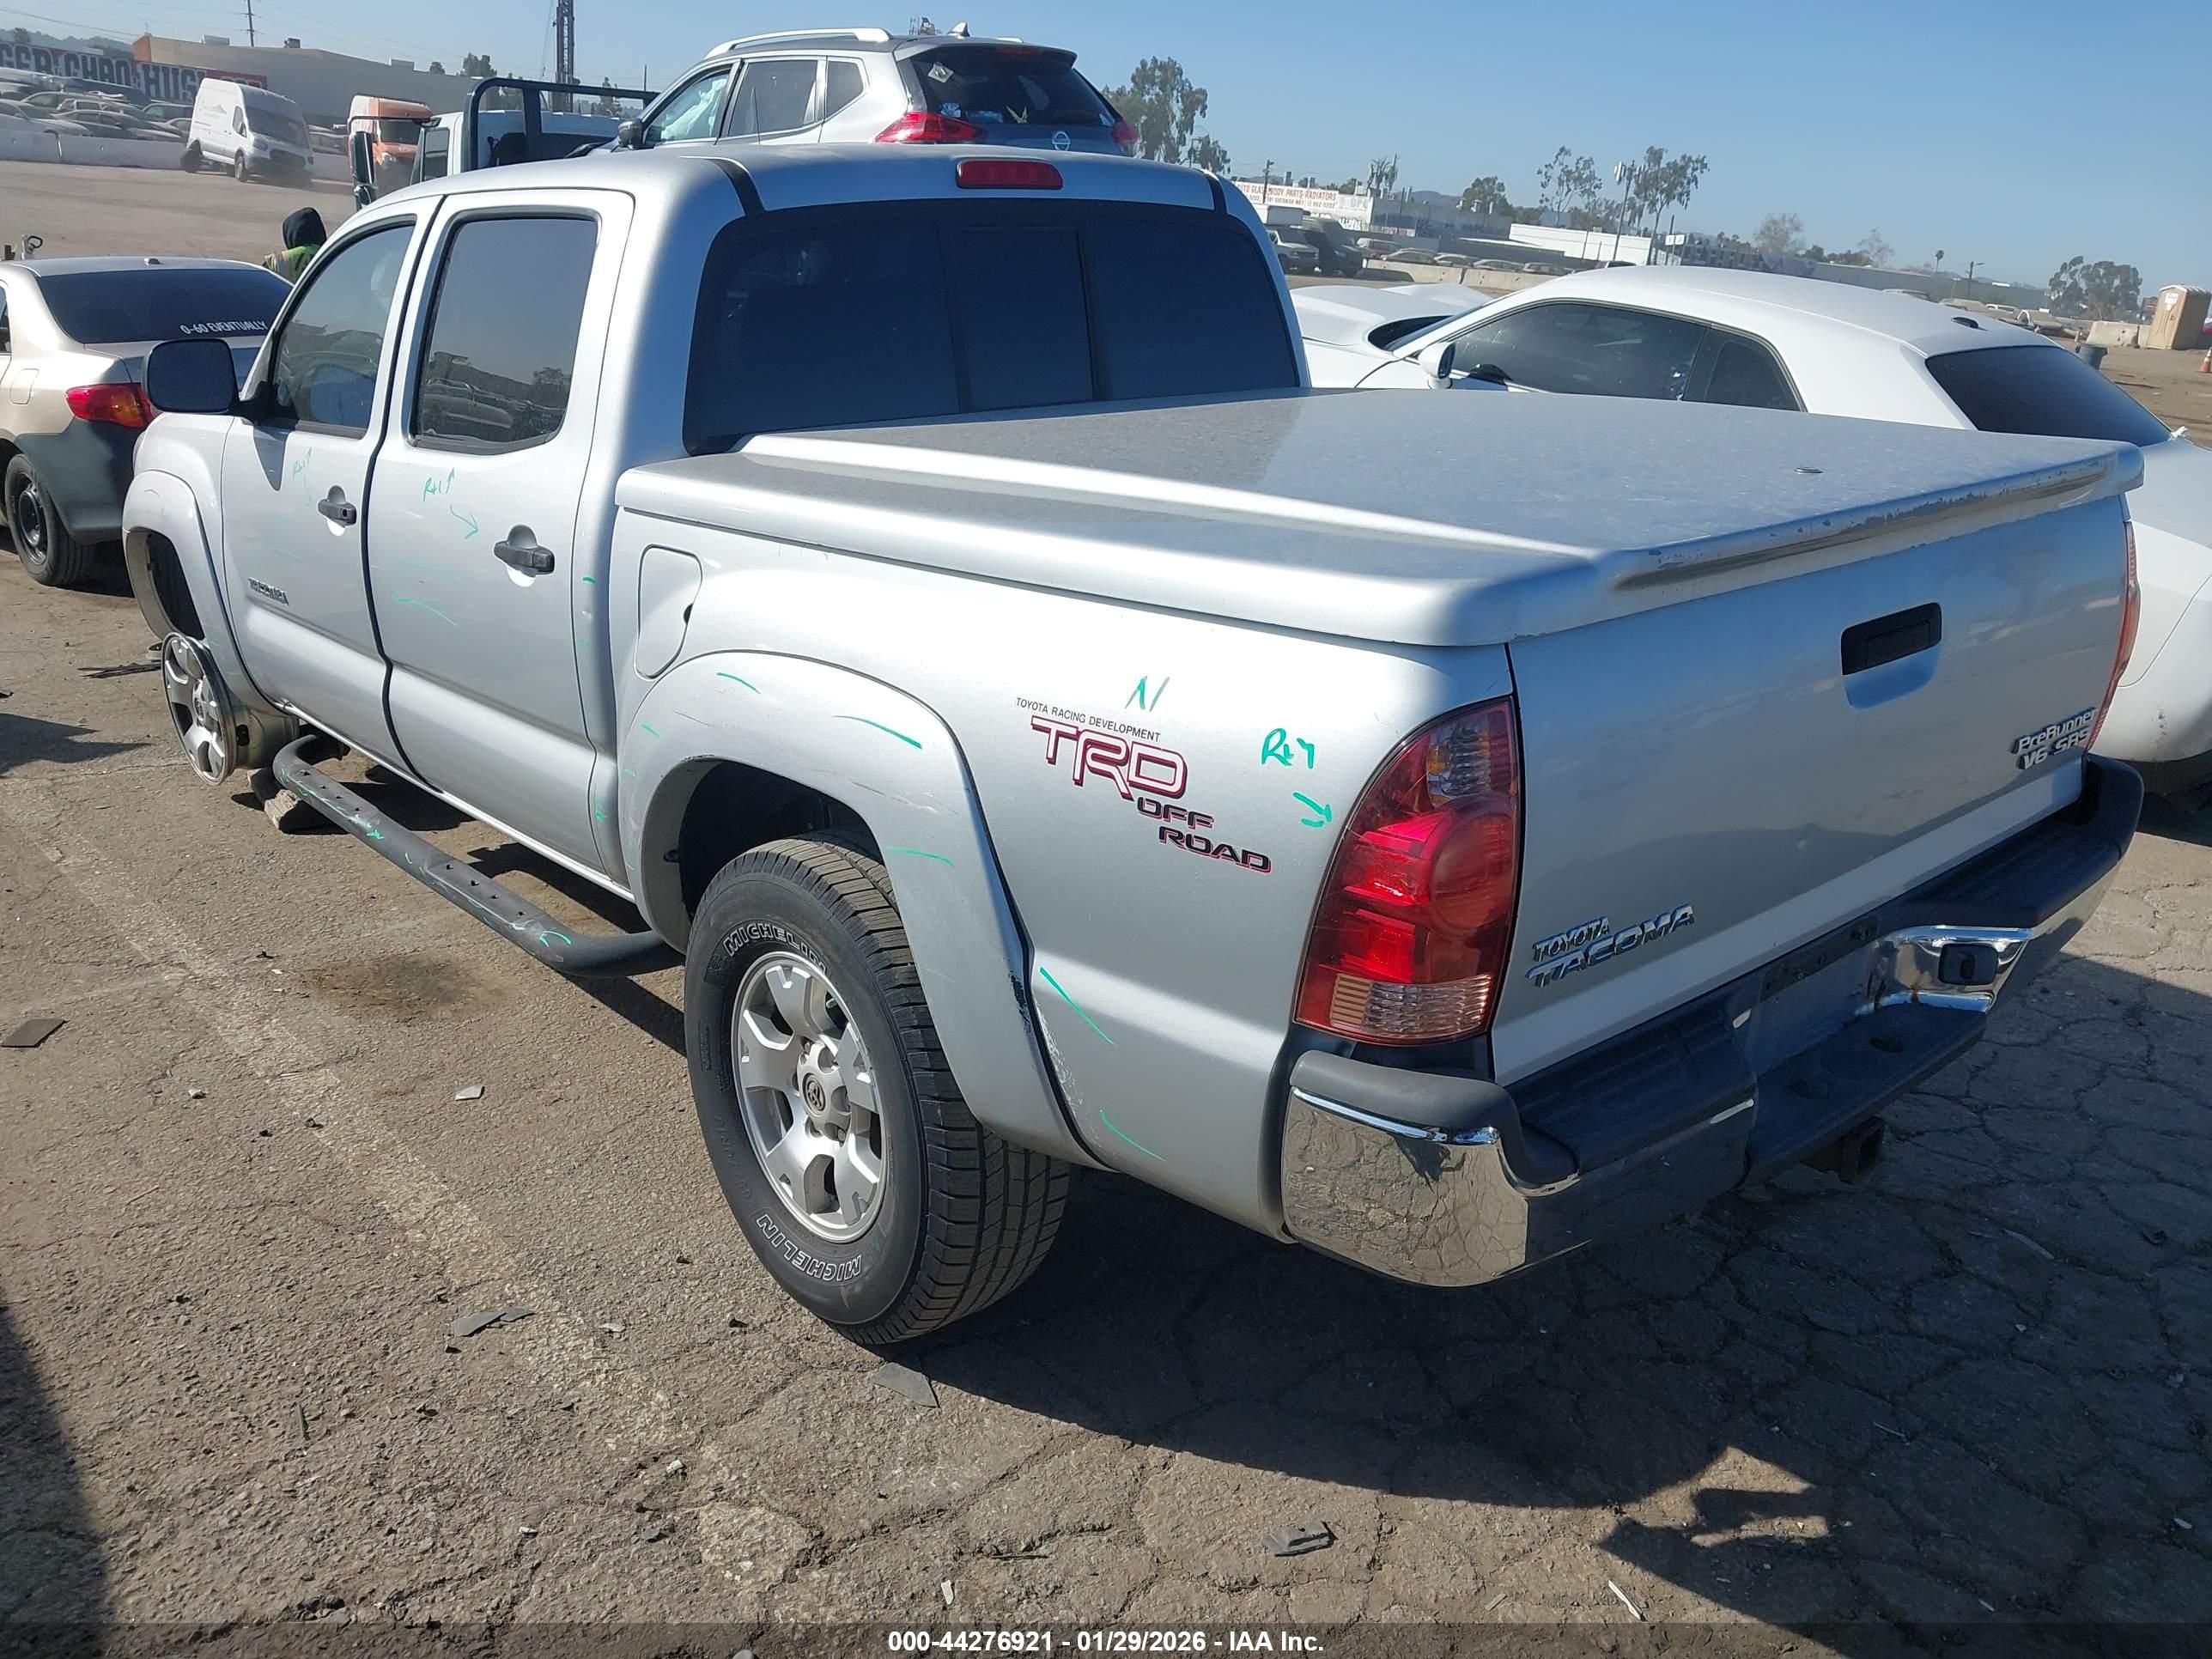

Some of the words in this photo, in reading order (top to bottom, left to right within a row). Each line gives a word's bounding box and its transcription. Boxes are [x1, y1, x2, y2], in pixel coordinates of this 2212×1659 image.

[180, 324, 208, 335] 0-60
[208, 320, 269, 333] EVENTUALLY
[1016, 697, 1048, 714] TOYOTA
[1051, 707, 1085, 724] RACING
[1088, 716, 1161, 742] DEVELOPMENT
[1030, 714, 1188, 801] TRD
[2019, 745, 2048, 769] V6
[1137, 796, 1214, 830] OFF
[1158, 826, 1271, 874] ROAD
[723, 921, 828, 975] MICHELIN
[1525, 902, 1694, 988] TACOMA
[1532, 916, 1609, 962] TOYOTA
[756, 1213, 861, 1282] MICHELIN
